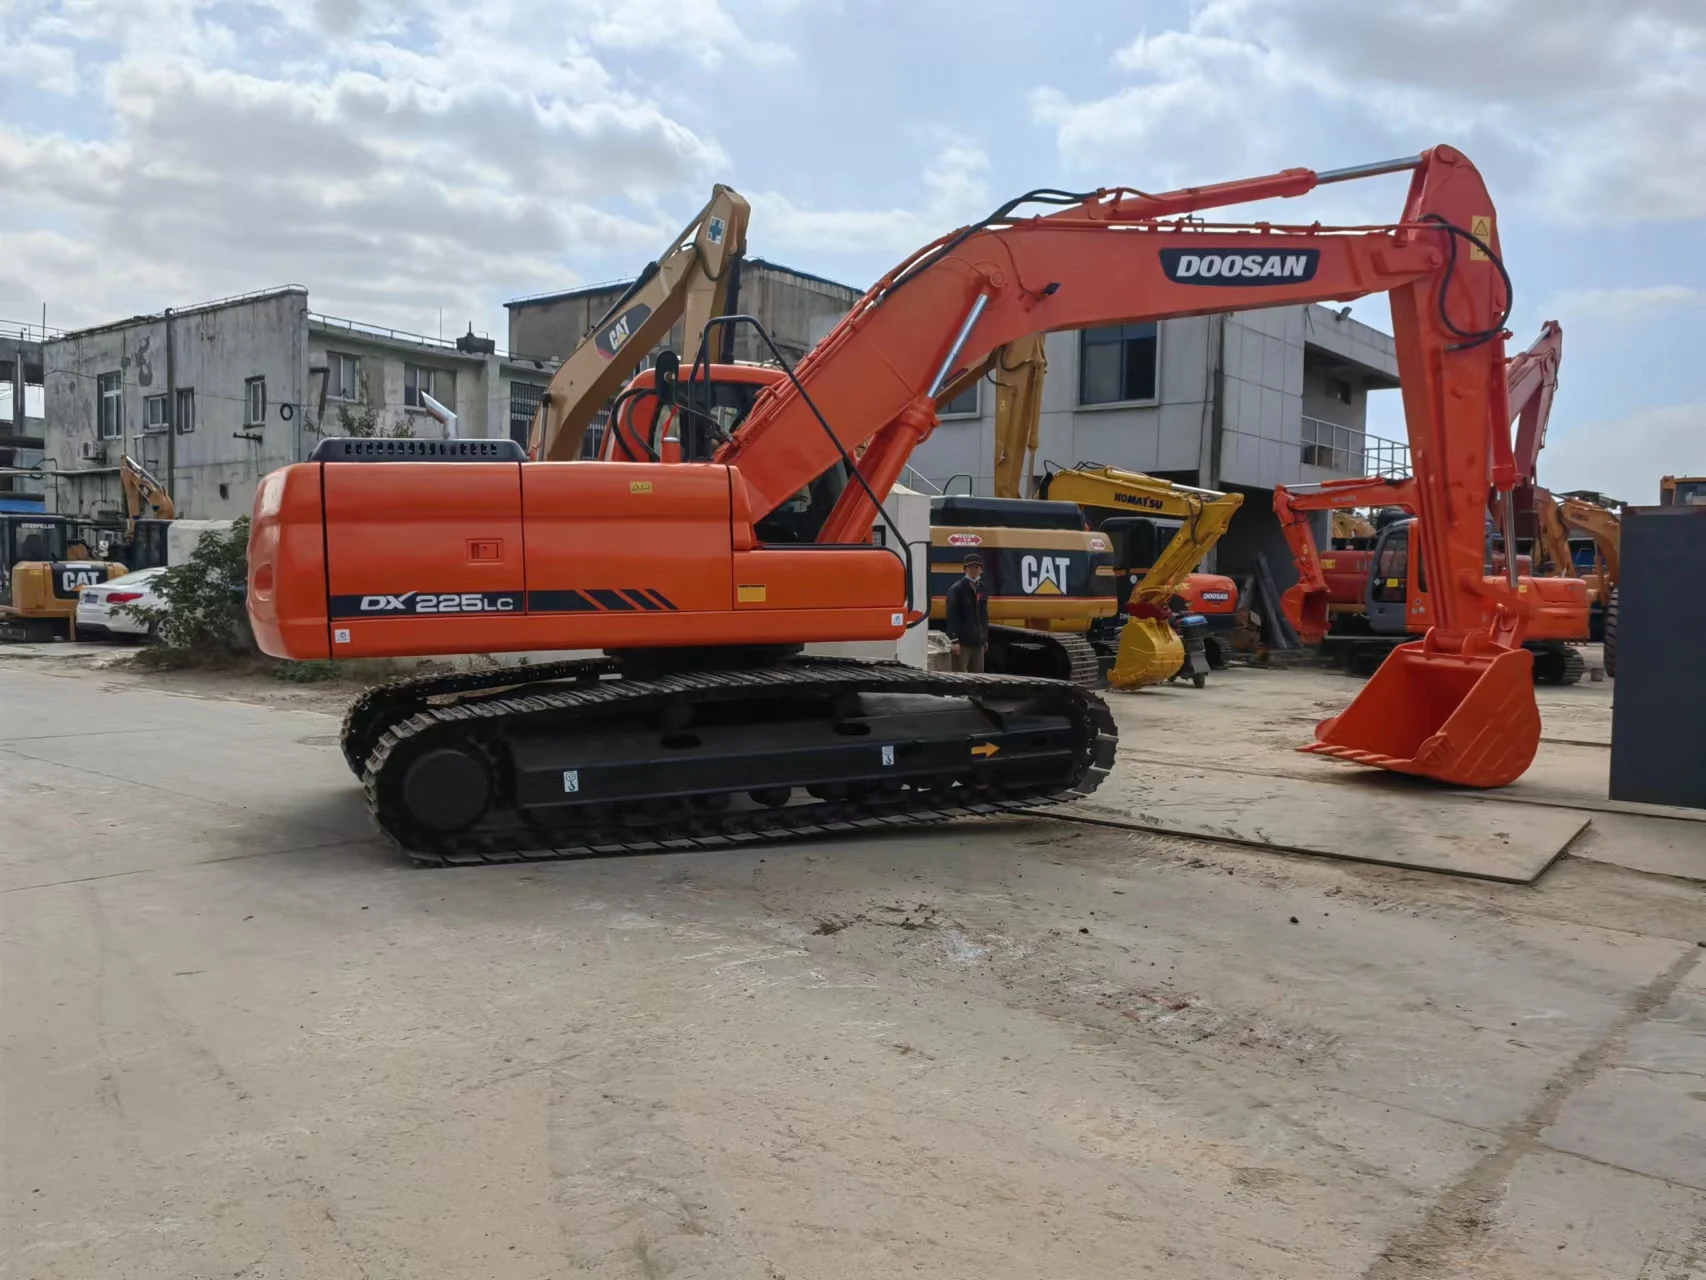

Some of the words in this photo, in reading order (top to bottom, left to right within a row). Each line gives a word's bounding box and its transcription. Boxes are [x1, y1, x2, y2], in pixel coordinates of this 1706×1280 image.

[1176, 254, 1308, 279] DOOSAN
[609, 315, 630, 350] CAT
[1114, 492, 1163, 510] KOMATSU
[62, 571, 99, 592] CAT
[1021, 554, 1071, 595] CAT
